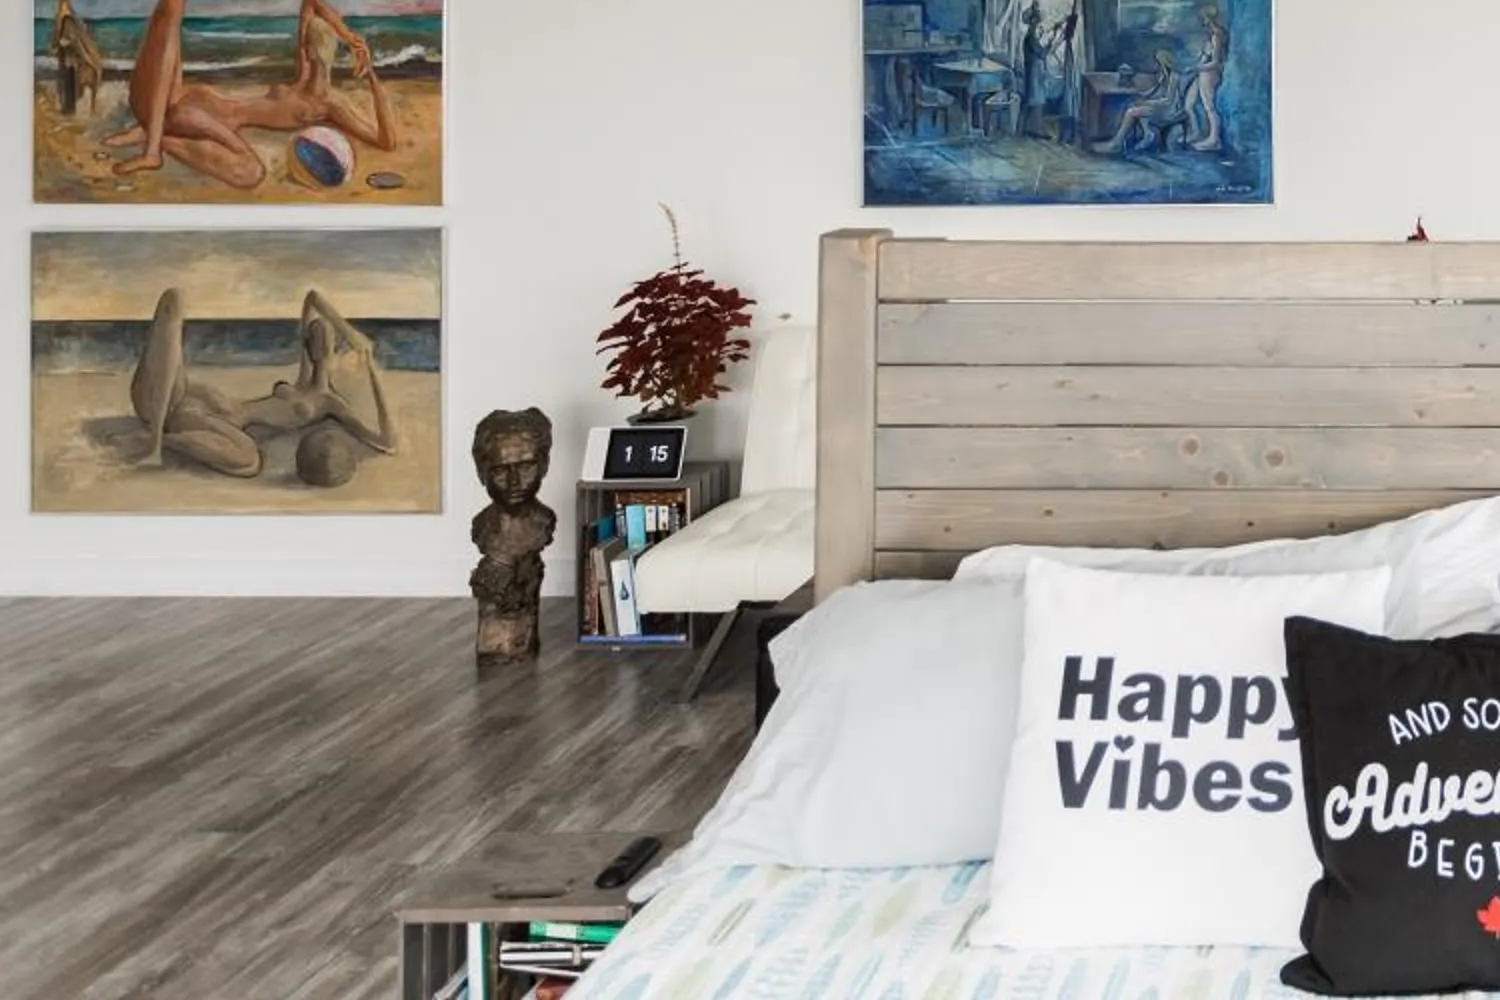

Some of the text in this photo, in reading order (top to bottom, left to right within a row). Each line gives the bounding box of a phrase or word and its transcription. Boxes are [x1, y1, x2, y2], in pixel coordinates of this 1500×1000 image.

[624, 445, 669, 463] 1 15
[1388, 701, 1451, 745] AND
[1055, 735, 1294, 812] Vibes
